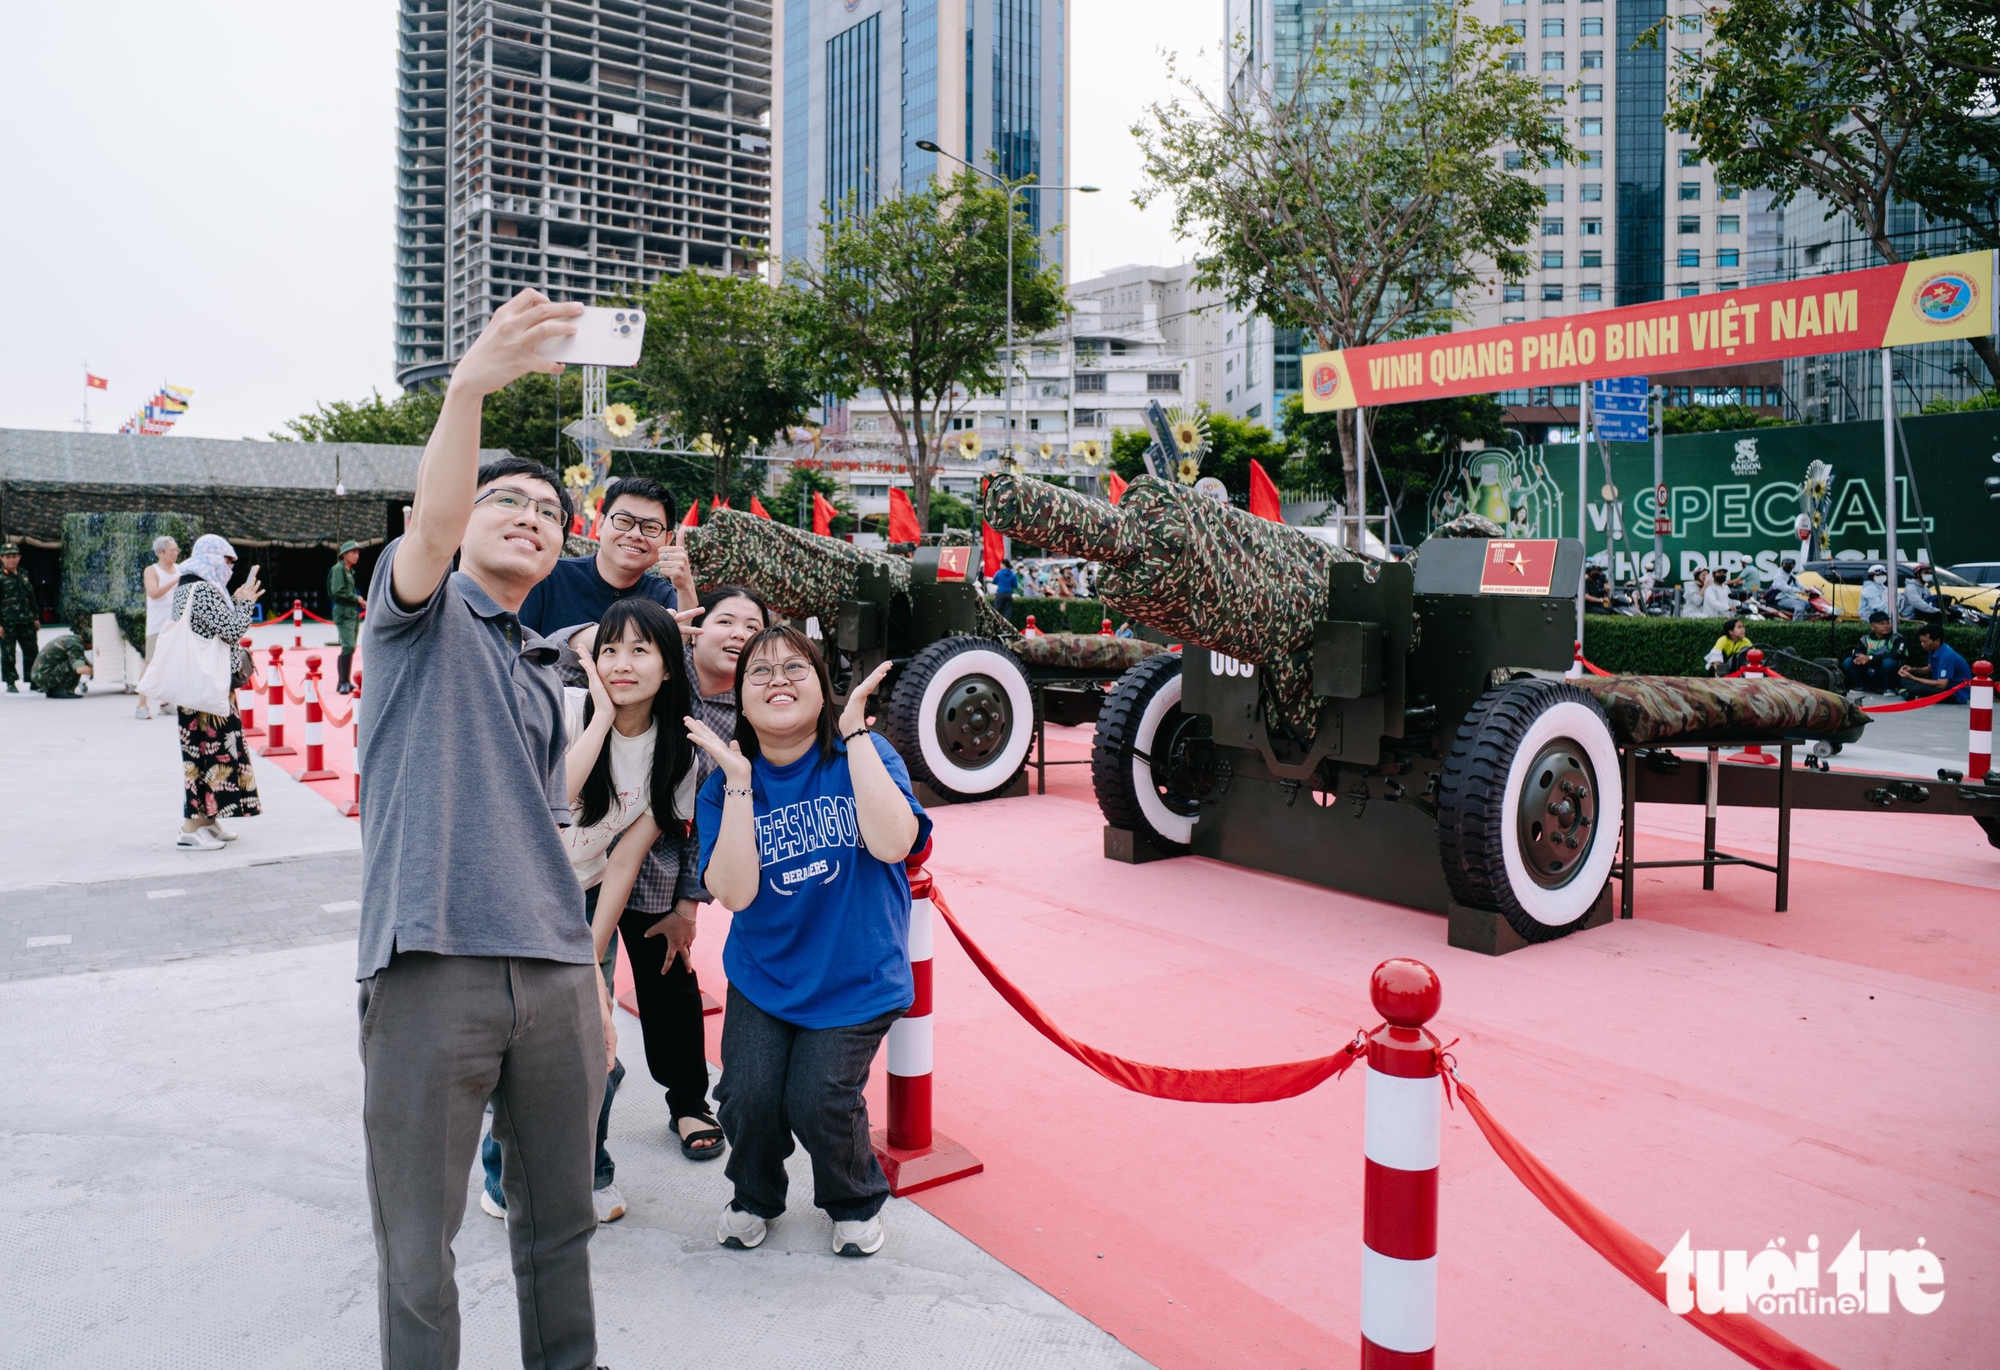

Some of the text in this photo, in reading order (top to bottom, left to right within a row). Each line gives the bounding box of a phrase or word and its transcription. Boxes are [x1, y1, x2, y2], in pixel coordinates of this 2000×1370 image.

[1368, 352, 1423, 391] VINH
[1430, 339, 1514, 387] QUANG
[1521, 322, 1596, 372] PHÁO
[1605, 314, 1679, 362] BINH
[1688, 298, 1760, 356] VIỆT
[1771, 289, 1858, 341] NAM
[1693, 392, 1730, 407] Payoo
[1730, 461, 1761, 472] SAIGON
[1632, 476, 1935, 539] SPECAL
[754, 796, 864, 869] EESAIGO
